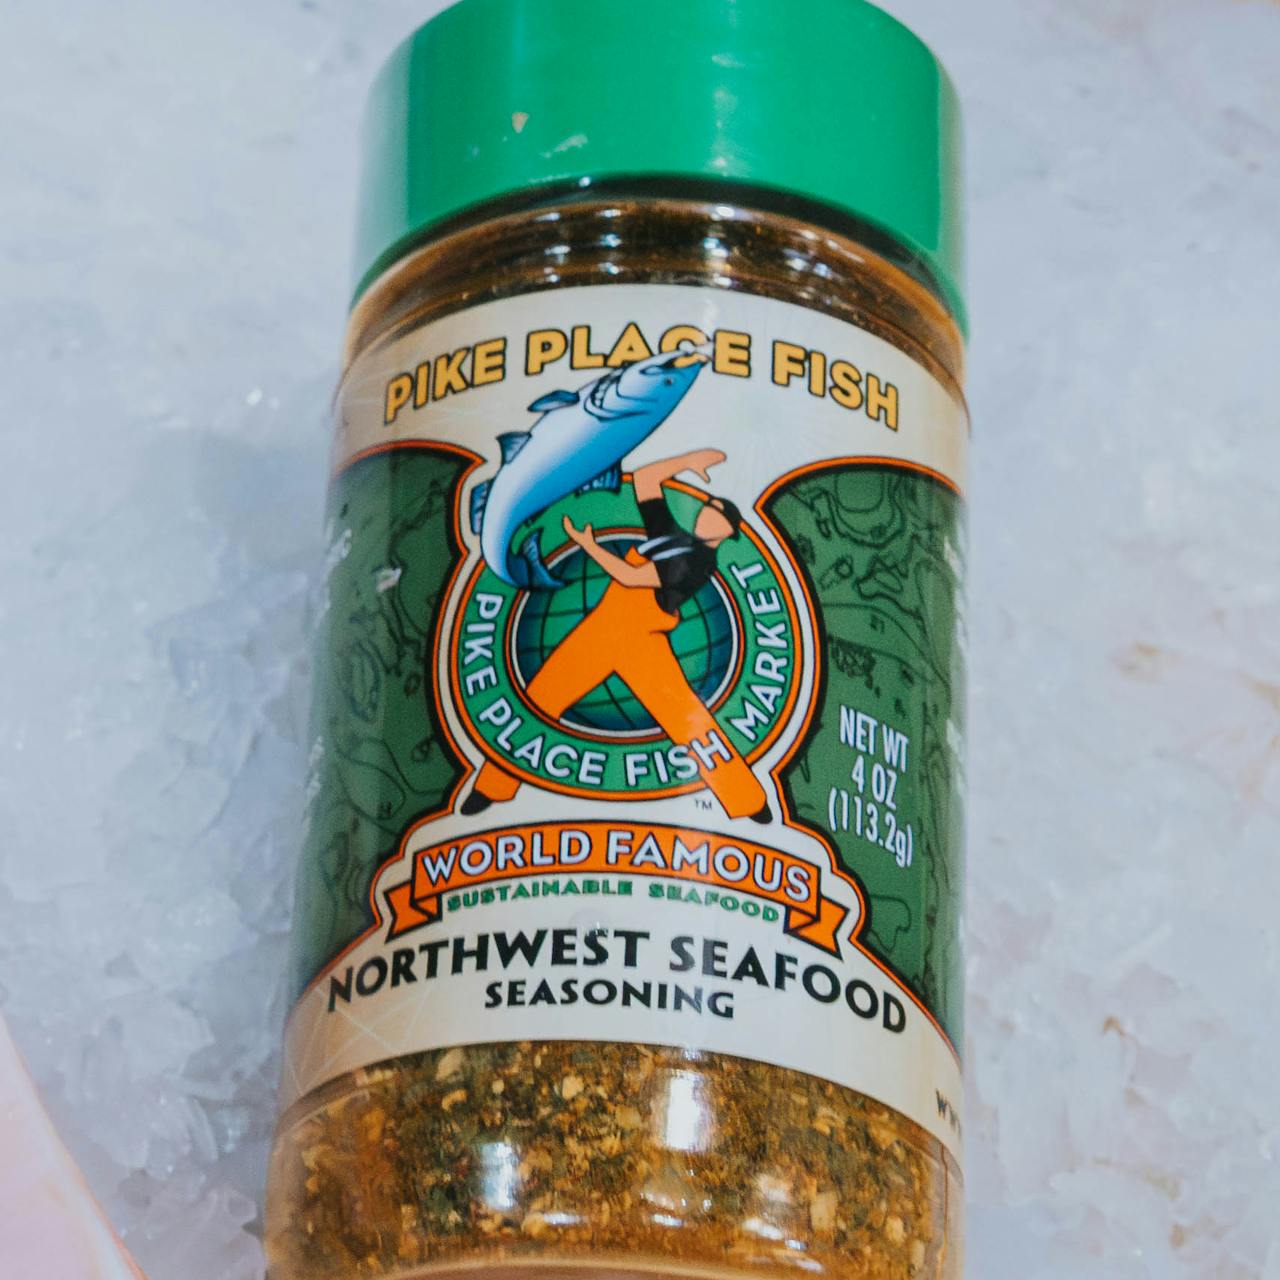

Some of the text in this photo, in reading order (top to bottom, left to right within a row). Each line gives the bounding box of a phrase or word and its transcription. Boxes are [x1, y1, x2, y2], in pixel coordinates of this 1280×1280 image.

[384, 321, 899, 432] PIKE PLACE FISH
[463, 562, 790, 787] PIKE PLACE FISH MARKET
[840, 704, 909, 773] NET WT
[851, 754, 898, 810] 4 OZ
[828, 787, 913, 868] (113.2g)
[421, 829, 812, 902] WORLD FAMOUS
[446, 878, 780, 923] SUSTAINABLE SEAFOOD
[326, 928, 907, 1034] NORTHWEST SEAFOOD
[484, 979, 735, 1019] SEASONING
